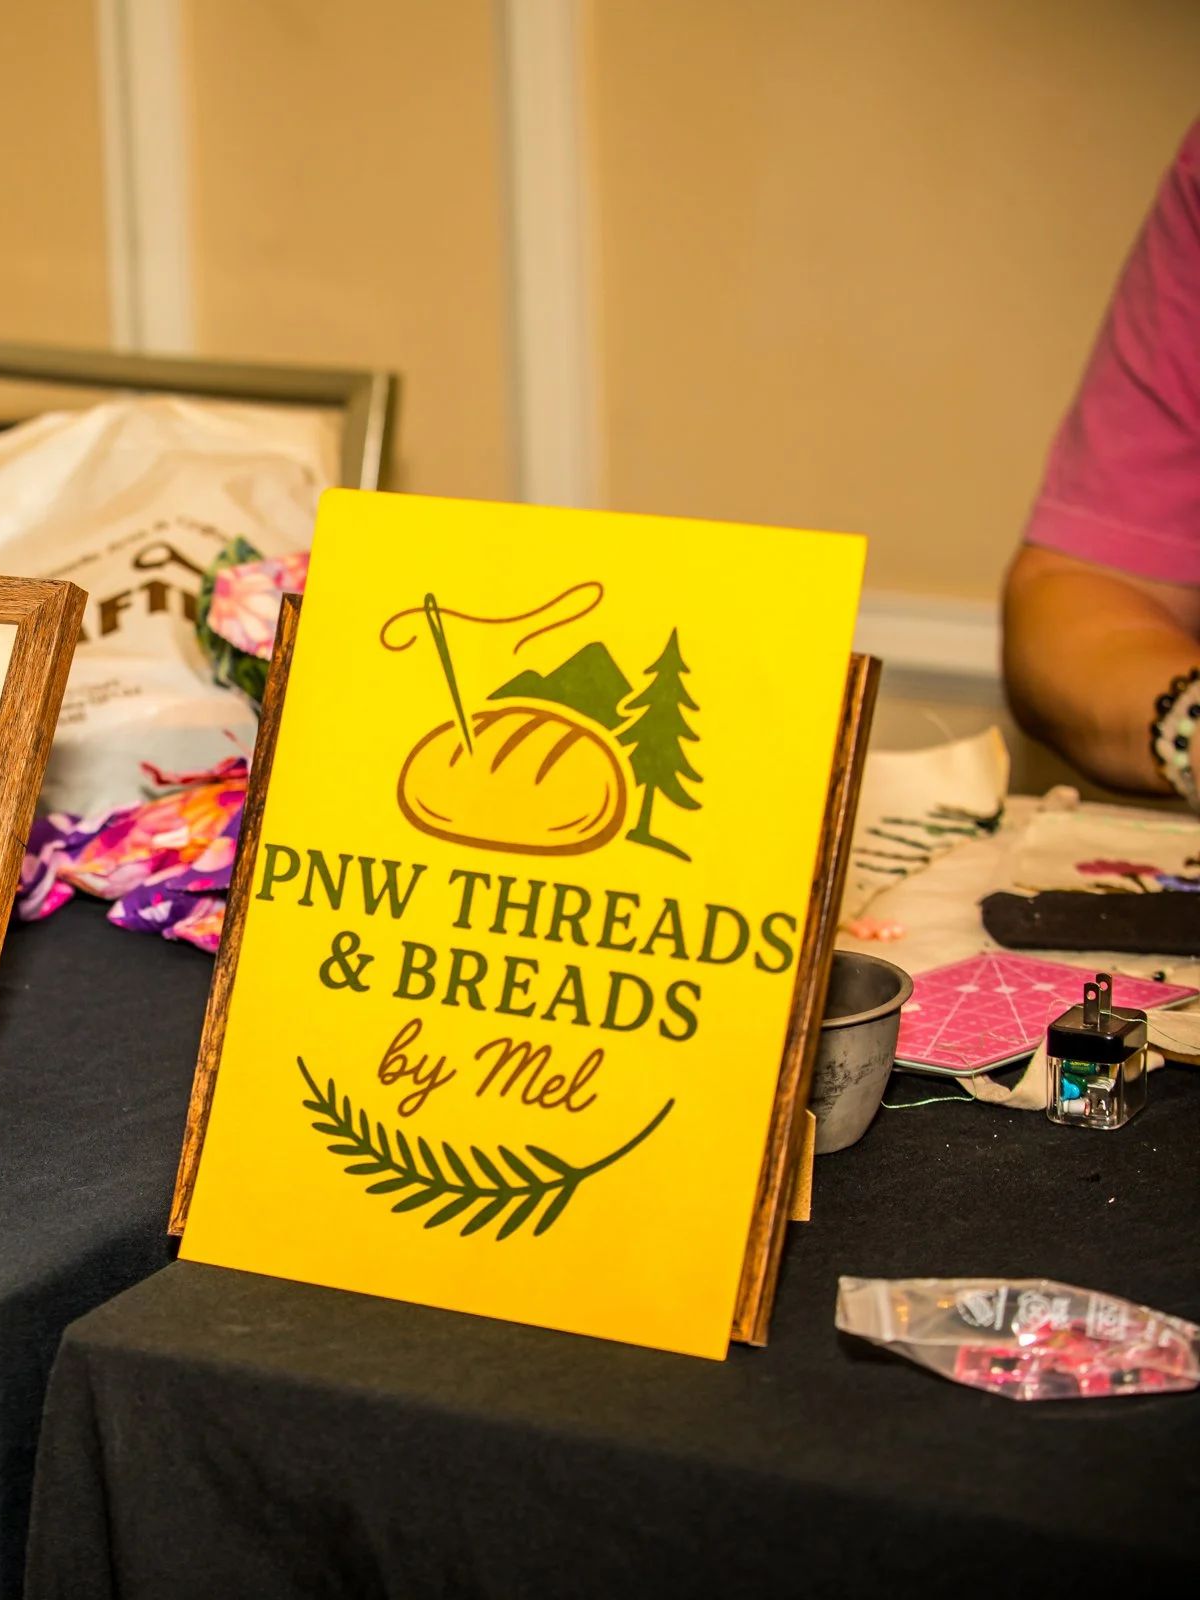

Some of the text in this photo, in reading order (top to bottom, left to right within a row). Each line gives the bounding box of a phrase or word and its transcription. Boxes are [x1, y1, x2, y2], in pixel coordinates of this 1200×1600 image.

[256, 843, 798, 975] PNW THREADS
[318, 930, 703, 1043] & BREADS
[377, 1017, 605, 1118] by Mel
